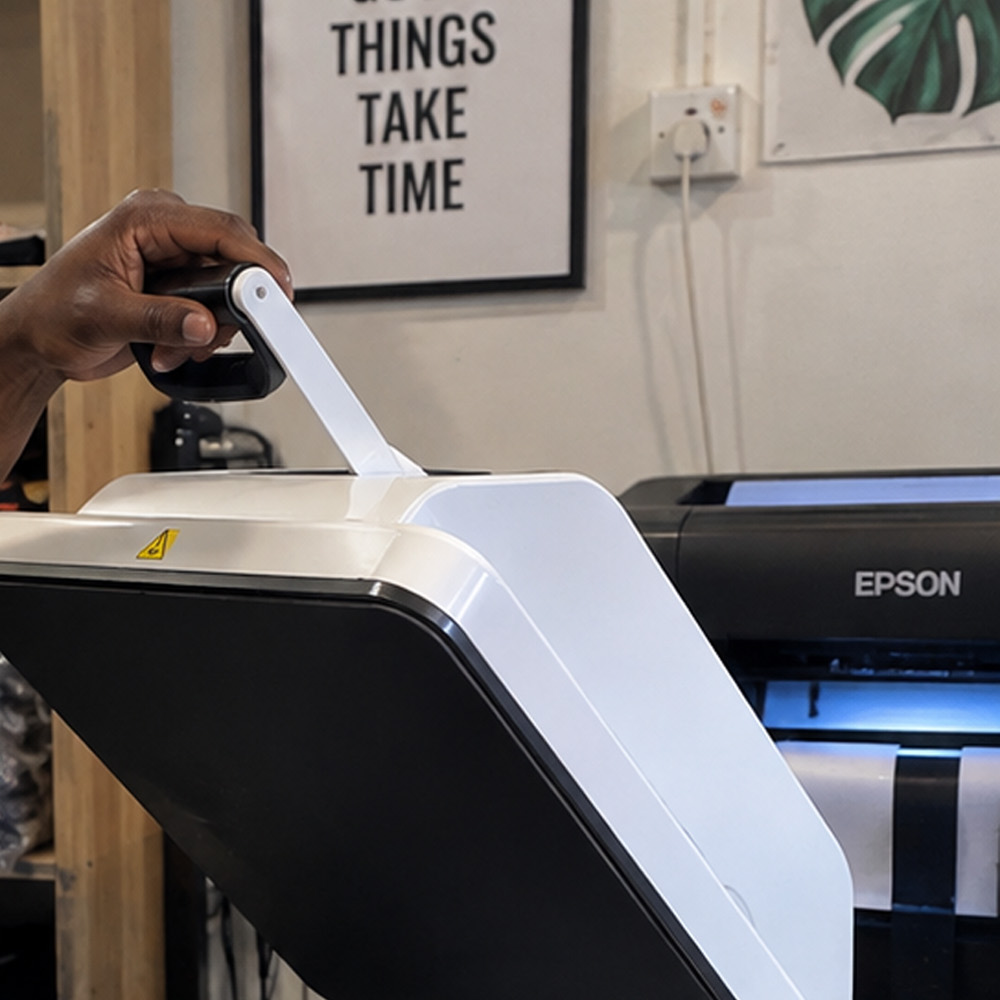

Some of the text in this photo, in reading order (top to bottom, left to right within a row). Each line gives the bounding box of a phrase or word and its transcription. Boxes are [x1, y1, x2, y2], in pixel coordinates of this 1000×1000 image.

[330, 11, 496, 76] THINGS
[357, 86, 467, 146] TAKE
[359, 158, 464, 216] TIME
[855, 570, 961, 597] EPSON
